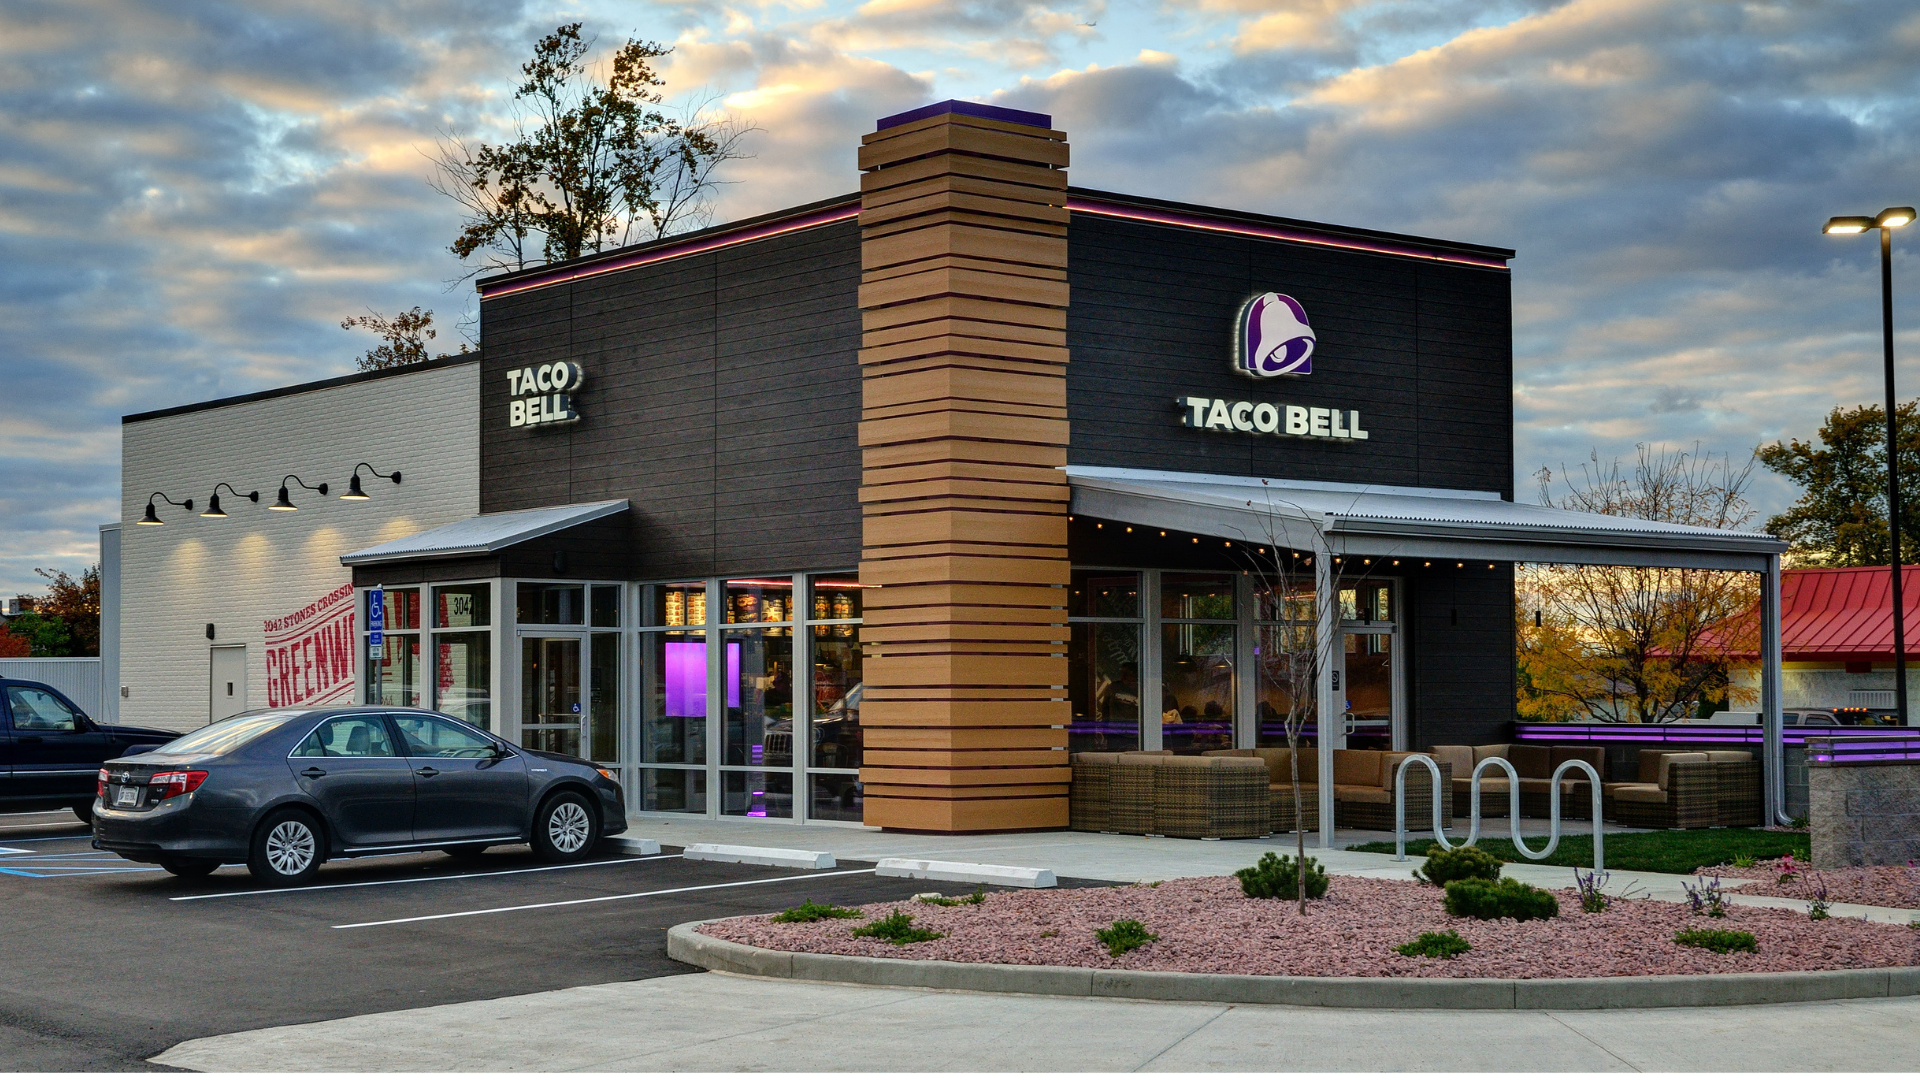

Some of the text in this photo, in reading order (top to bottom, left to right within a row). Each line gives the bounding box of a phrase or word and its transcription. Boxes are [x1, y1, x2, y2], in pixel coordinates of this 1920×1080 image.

[506, 361, 569, 396] TACO
[509, 393, 568, 427] BELL
[1186, 396, 1369, 440] TACO BELL
[263, 582, 354, 632] 3042 STONES CROSSIN
